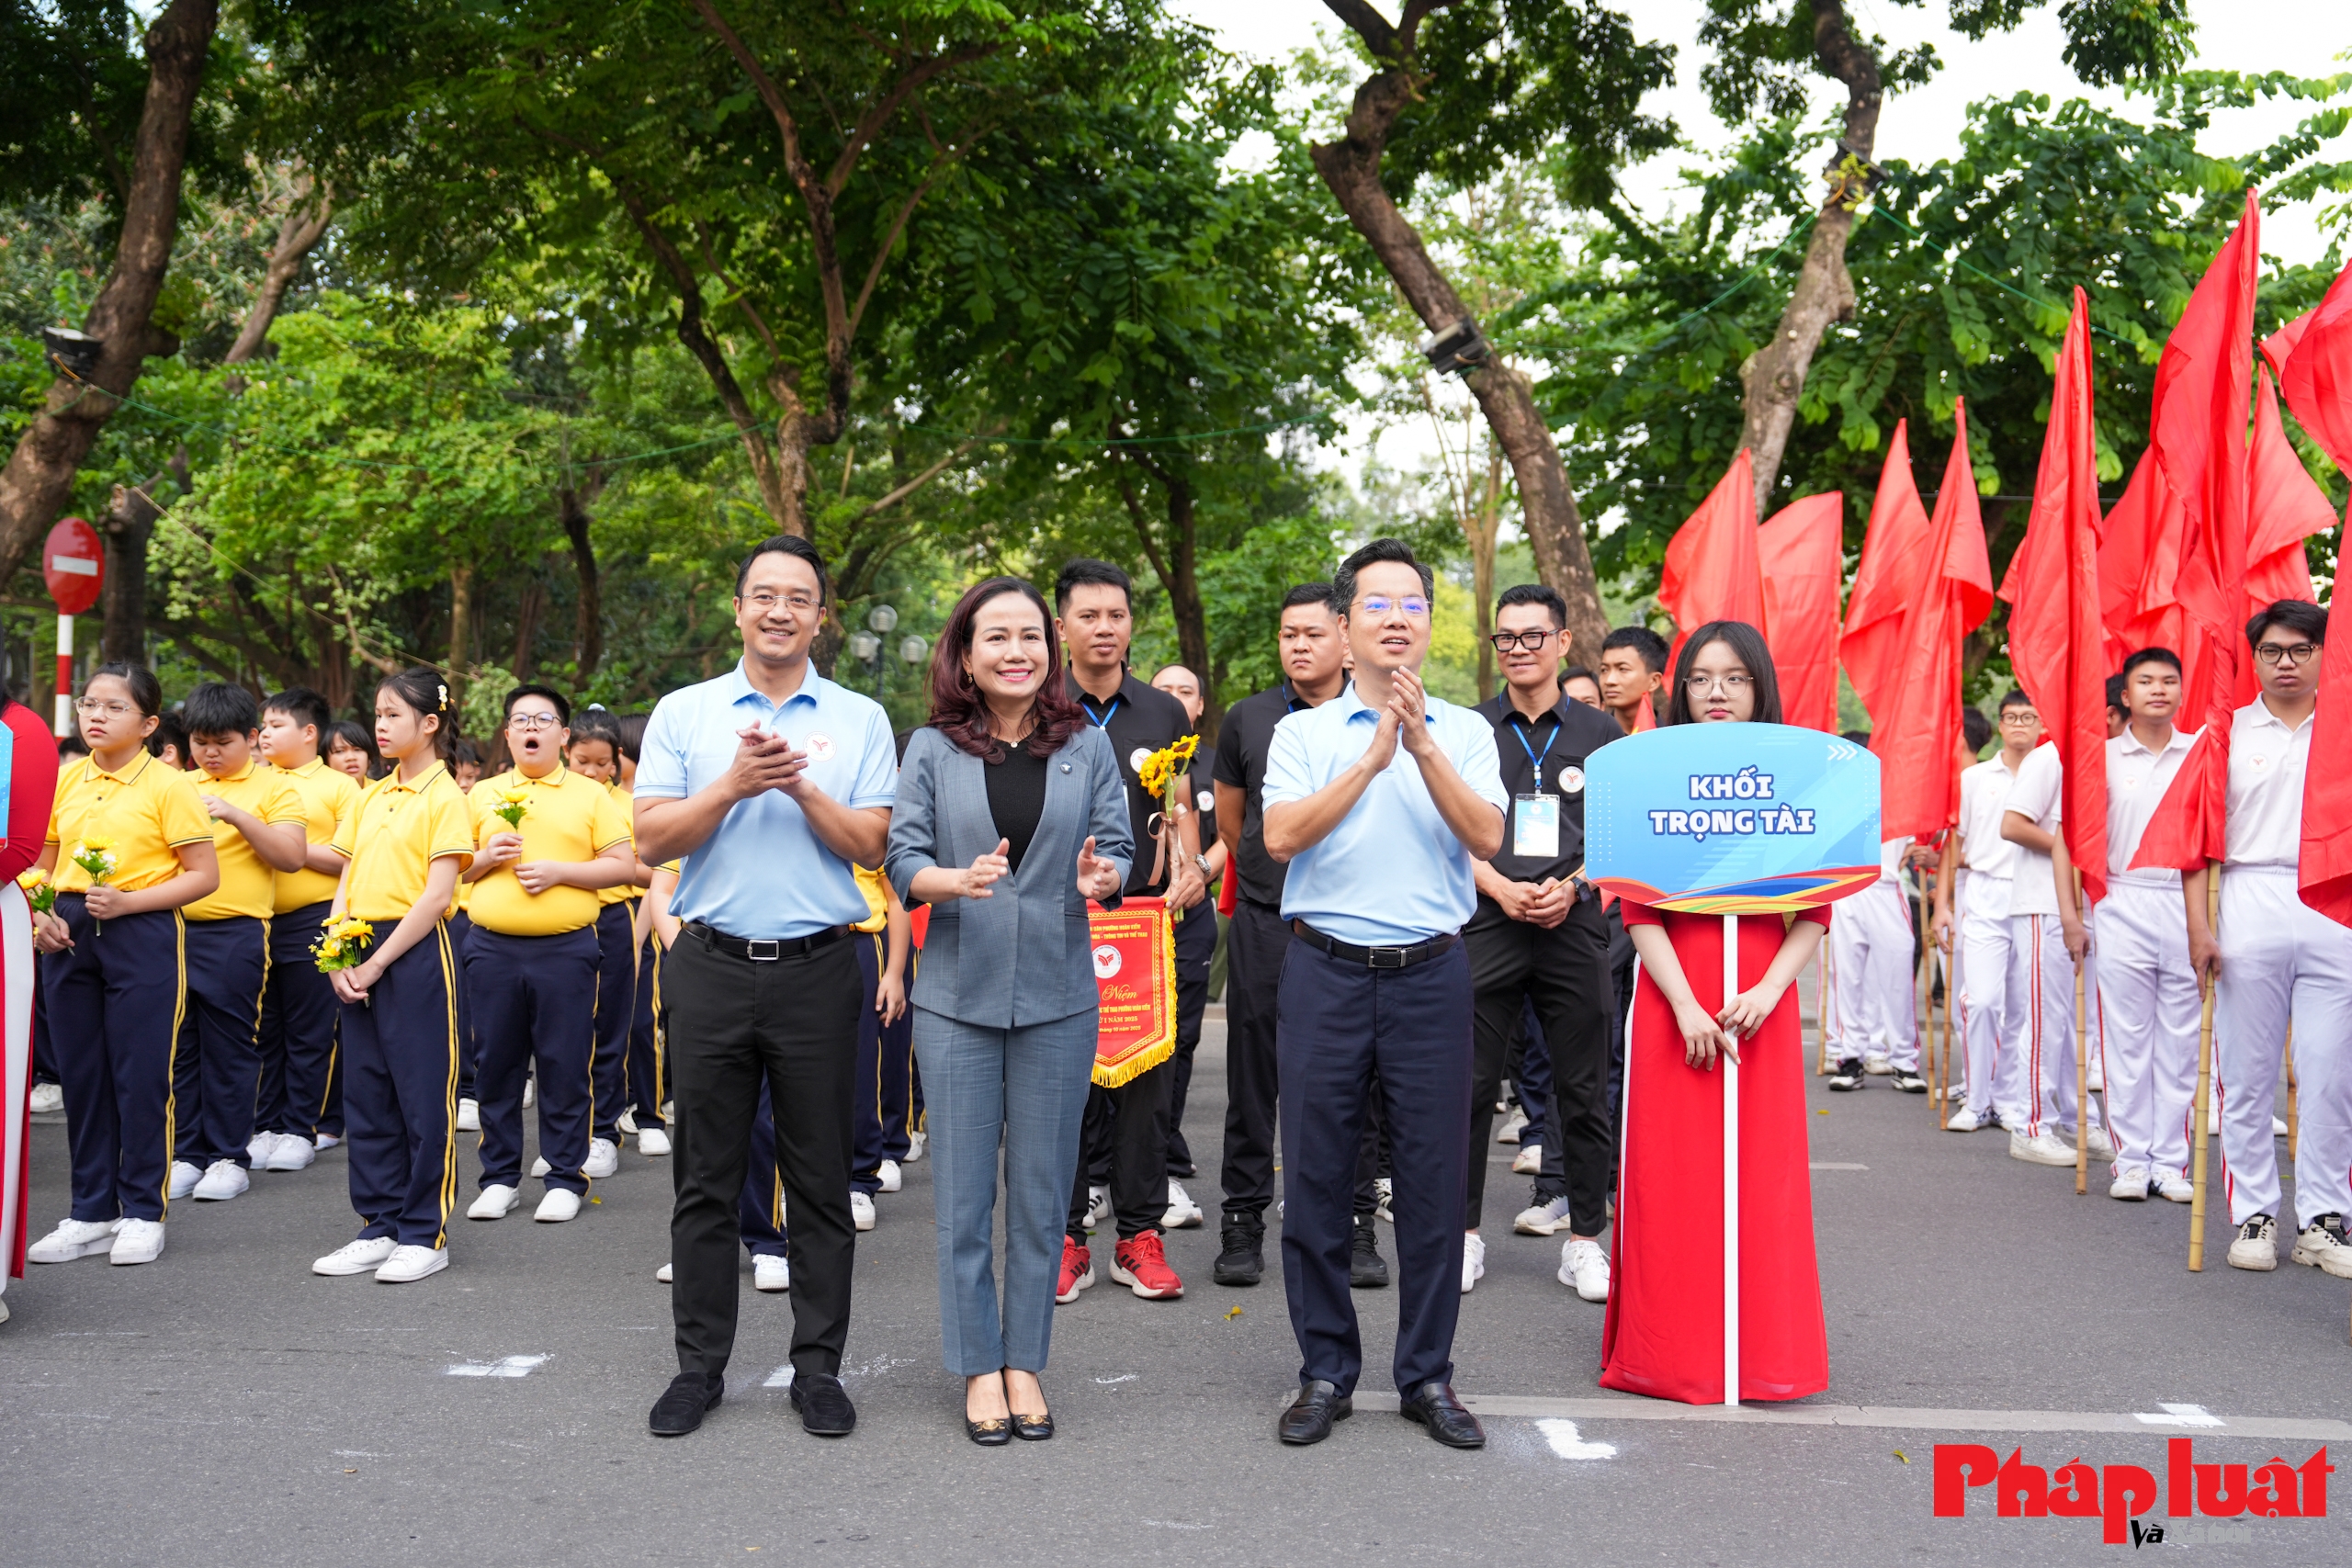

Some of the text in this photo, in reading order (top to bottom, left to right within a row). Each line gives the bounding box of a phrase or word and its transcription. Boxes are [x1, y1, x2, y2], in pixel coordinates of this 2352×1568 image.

[1689, 764, 1774, 800] KHỐI
[1648, 802, 1815, 842] TRỌNG TÀI
[1102, 984, 1137, 1001] Niệm
[1108, 1015, 1123, 1023] NĂM
